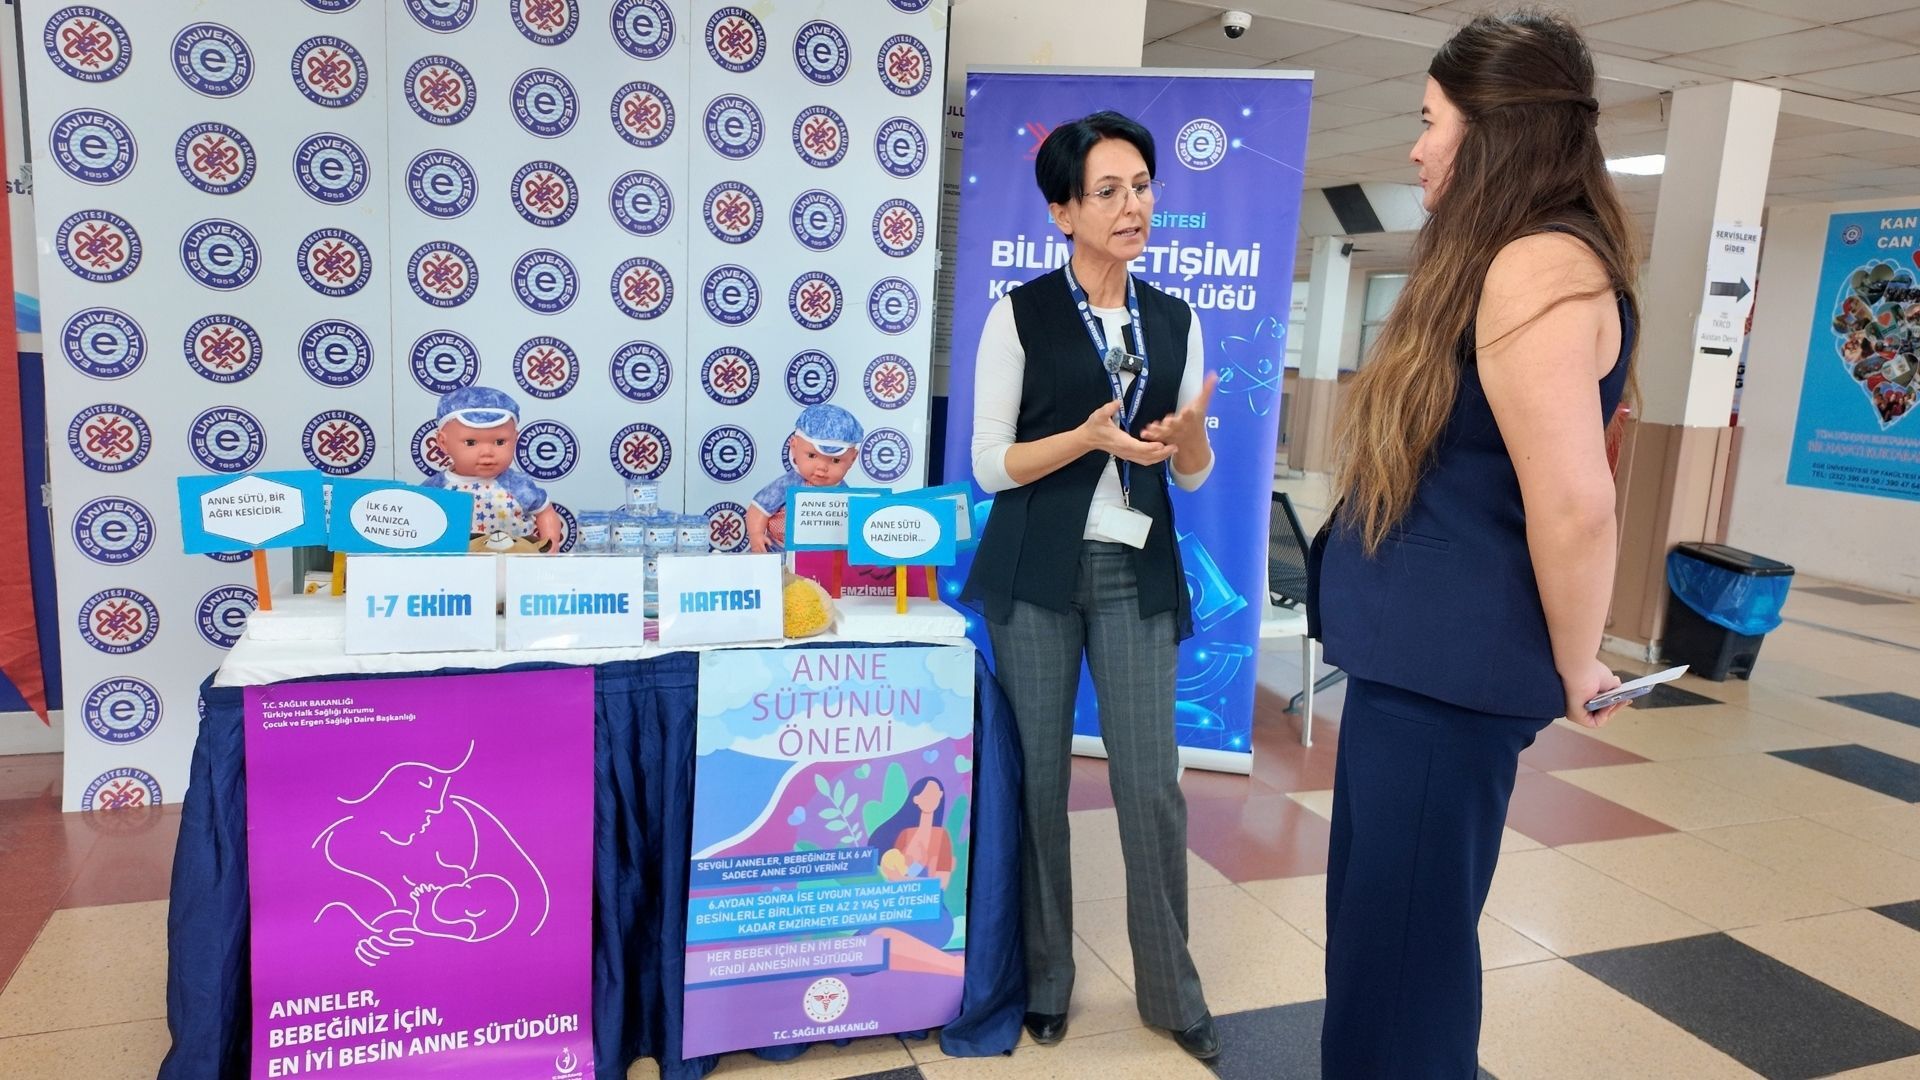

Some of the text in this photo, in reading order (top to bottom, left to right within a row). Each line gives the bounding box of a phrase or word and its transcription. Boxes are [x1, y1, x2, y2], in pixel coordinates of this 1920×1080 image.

[49, 51, 65, 68] EGE
[99, 13, 115, 25] TIP
[798, 25, 846, 78] EGE ÜNİVERSİTESİ
[178, 28, 246, 89] EGE ÜNİVERSİTESİ
[200, 49, 226, 72] e
[813, 43, 831, 63] e
[57, 115, 129, 175] EGE ÜNİVERSİTESİ
[80, 135, 107, 159] e
[181, 165, 195, 182] EGE
[227, 128, 241, 139] TIP
[1180, 123, 1223, 163] EGE ÜNİVERSİTESİ
[1193, 137, 1209, 152] e
[1881, 217, 1917, 229] KAN
[1716, 230, 1757, 241] SERVİSLERE
[1878, 236, 1913, 248] CAN
[1725, 245, 1745, 253] GİDER
[517, 376, 529, 389] EGE
[555, 341, 567, 350] TIP
[73, 447, 89, 462] EGE
[121, 408, 136, 418] TIP
[208, 492, 285, 505] ANNE SÜTÜ, BİR
[366, 501, 380, 510] İLK
[209, 508, 232, 518] AĞRI
[366, 514, 410, 526] YALNIZCA
[898, 520, 920, 528] SÜTÜ
[364, 526, 417, 538] ANNE SÜTÜ
[520, 588, 629, 616] EMZİRME
[680, 589, 760, 611] HAFTASI
[841, 585, 895, 596] EMZİRME
[366, 588, 471, 618] 1-7 EKİM
[792, 654, 887, 682] ANNE
[89, 682, 155, 735] EGE ÜNİVERSİTESİ
[110, 700, 135, 721] e
[263, 711, 292, 719] Türkiye
[314, 708, 341, 716] Sağlığı
[279, 700, 308, 708] SAĞLIK
[310, 698, 353, 706] BAKANLIĞI
[752, 685, 920, 721] SÜTÜNÜN
[263, 721, 288, 729] Çocuk
[325, 717, 352, 726] Sağlığı
[376, 714, 416, 722] Başkanlığı
[779, 720, 892, 756] ÖNEMİ
[698, 849, 873, 871] SEVGİLİ ANNELER, BEBEĞİNİZE İLK 6 AY
[722, 862, 848, 880] SADECE ANNE SÜTÜ VERİNİZ
[697, 893, 940, 924] BESİNLERLE BİRLİKTE EN AZ 2 YAŞ VE ÖTESİNE
[709, 883, 920, 910] 6.AYDAN SONRA İSE UYGUN TAMAMLAYICI
[738, 908, 912, 933] KADAR EMZİRMEYE DEVAM EDİNİZ
[707, 937, 866, 963] HER BEBEK İÇİN EN İYİ BESİN
[710, 952, 863, 977] KENDİ ANNESİNİN SÜTÜDÜR
[269, 989, 380, 1019] ANNELER,
[269, 1006, 444, 1048] BEBEĞİNİZ İÇİN,
[773, 1020, 878, 1039] T.C. SAĞLIK BAKANLIĞI
[268, 1014, 578, 1077] EN İYİ BESİN ANNE SÜTÜDÜR!
